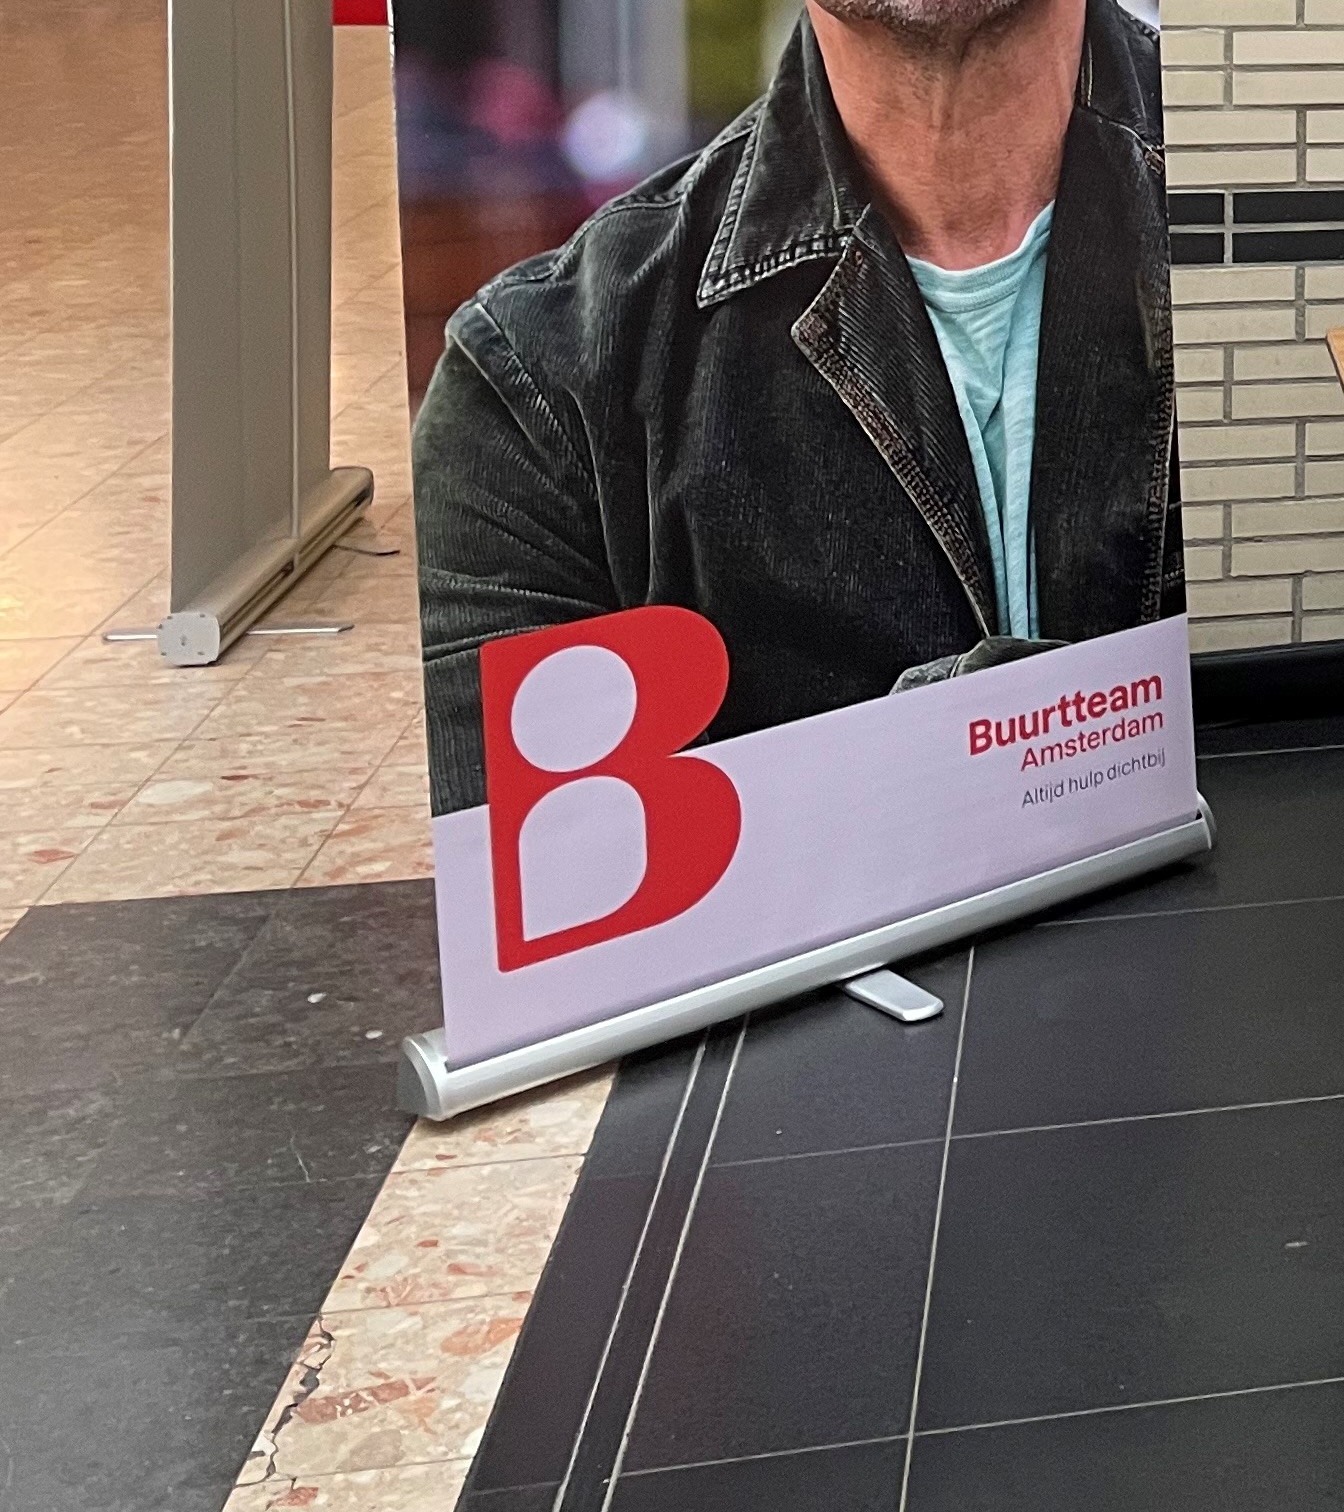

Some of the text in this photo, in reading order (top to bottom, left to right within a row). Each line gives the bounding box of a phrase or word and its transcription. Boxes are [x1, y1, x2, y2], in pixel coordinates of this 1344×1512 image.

[968, 674, 1163, 756] Buurtteam
[1020, 711, 1164, 772] Amsterdam
[1021, 747, 1167, 809] Altijd hulp dichtbij
